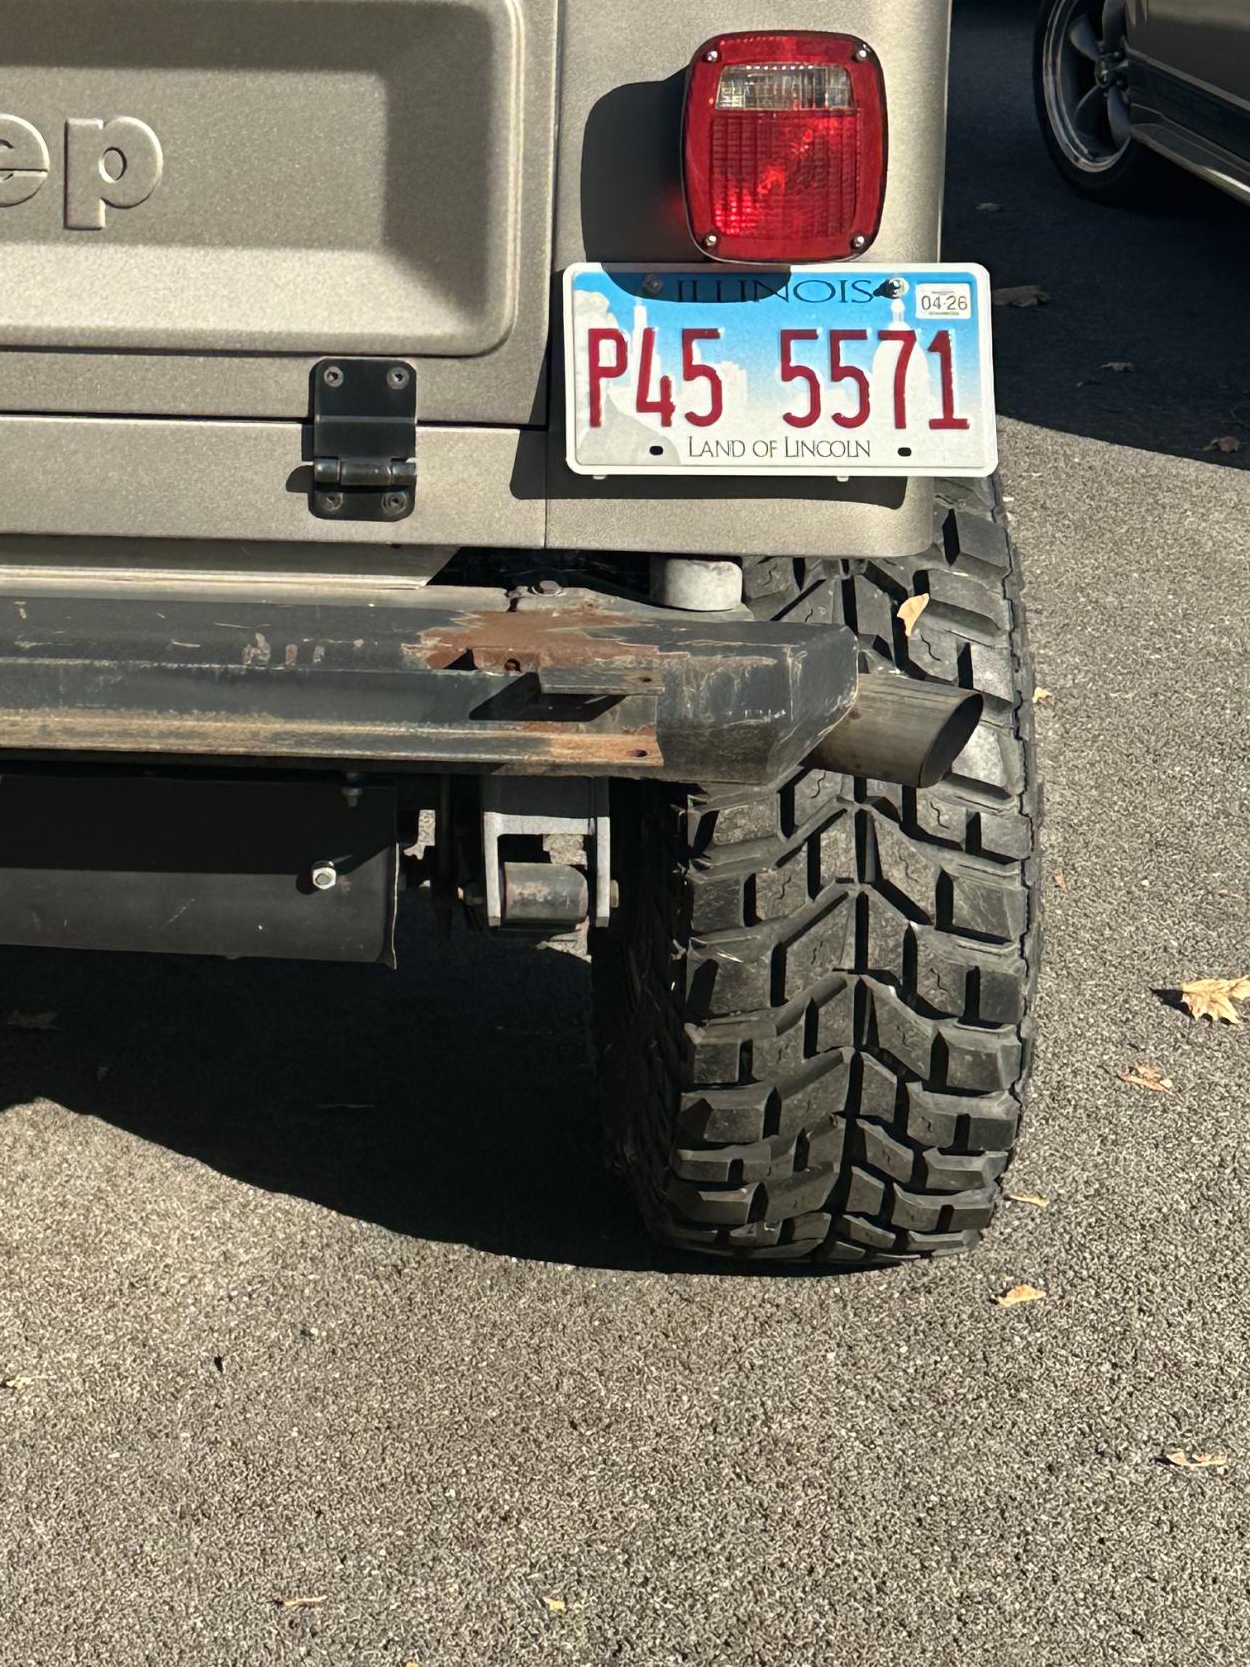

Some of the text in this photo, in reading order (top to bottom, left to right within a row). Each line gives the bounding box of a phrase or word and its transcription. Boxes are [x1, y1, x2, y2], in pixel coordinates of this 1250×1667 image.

[677, 279, 873, 303] ILLINOIS
[588, 327, 970, 431] P45 5571
